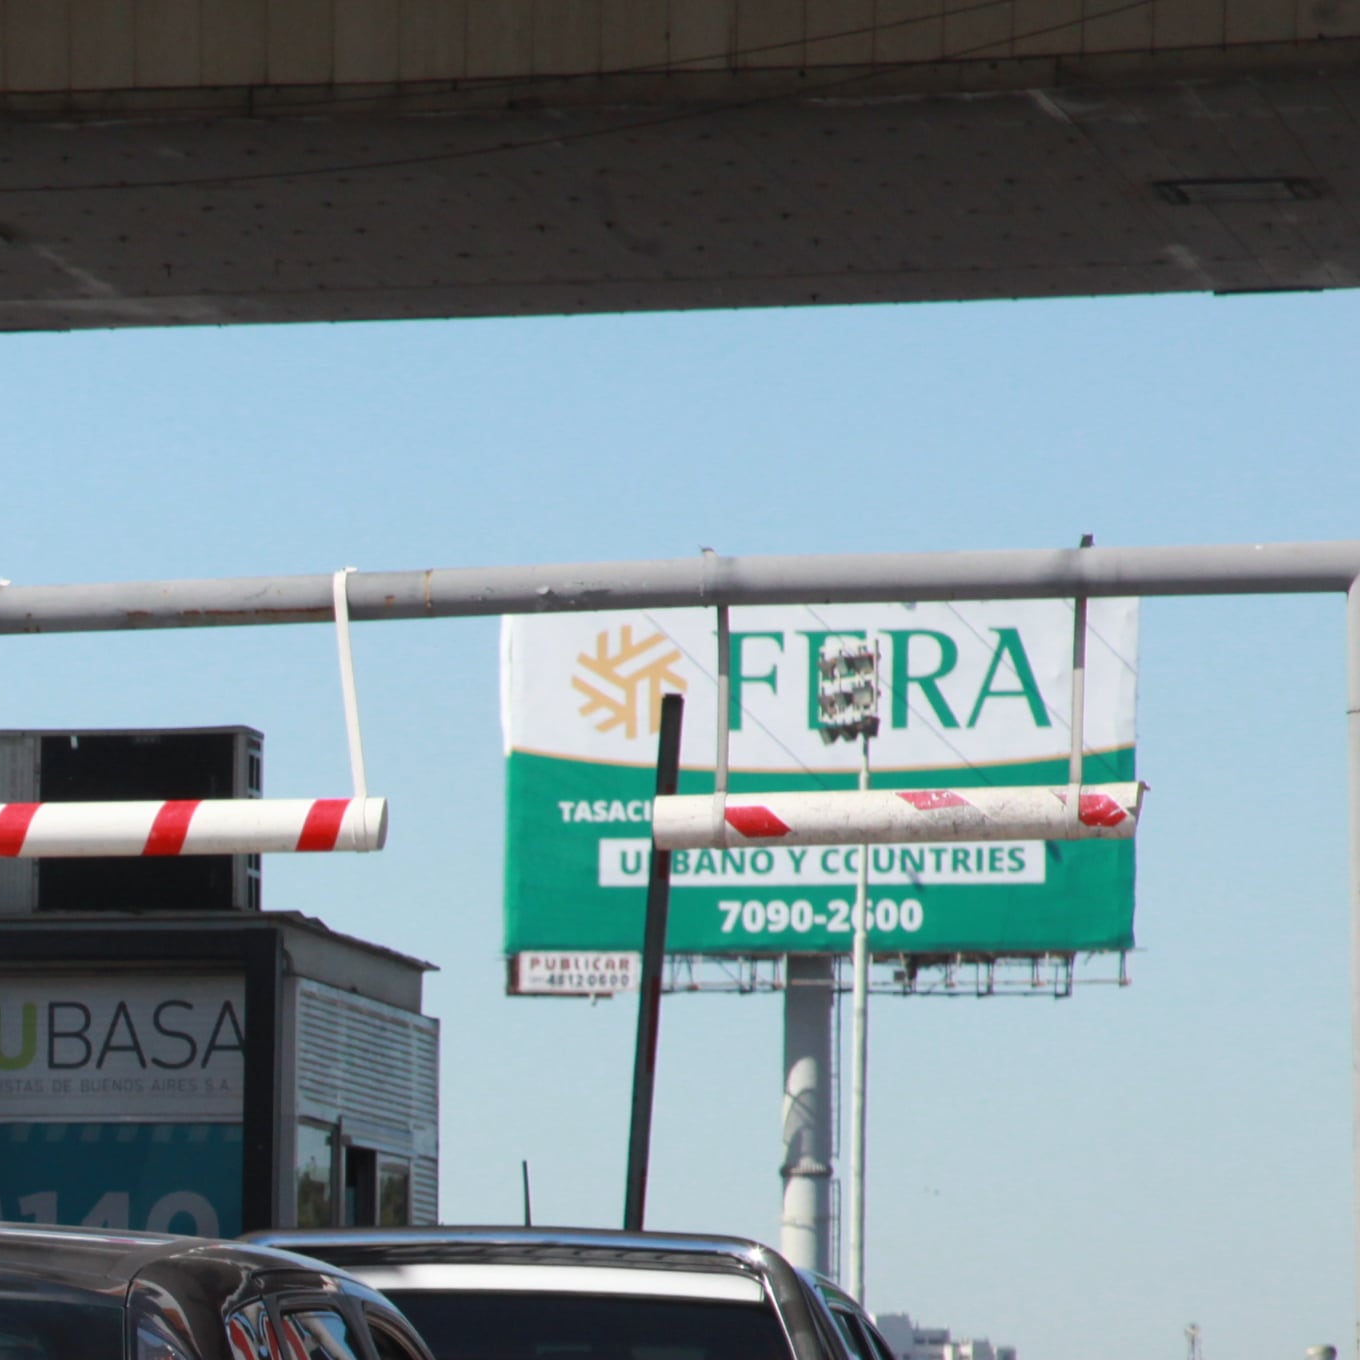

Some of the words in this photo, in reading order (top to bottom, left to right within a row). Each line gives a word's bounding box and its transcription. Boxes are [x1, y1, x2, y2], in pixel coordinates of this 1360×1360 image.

[620, 849, 775, 875] UBANO
[781, 848, 805, 874] Y
[530, 957, 629, 971] PUBLICAR
[53, 1079, 72, 1093] DE
[81, 1079, 144, 1093] BUENOS
